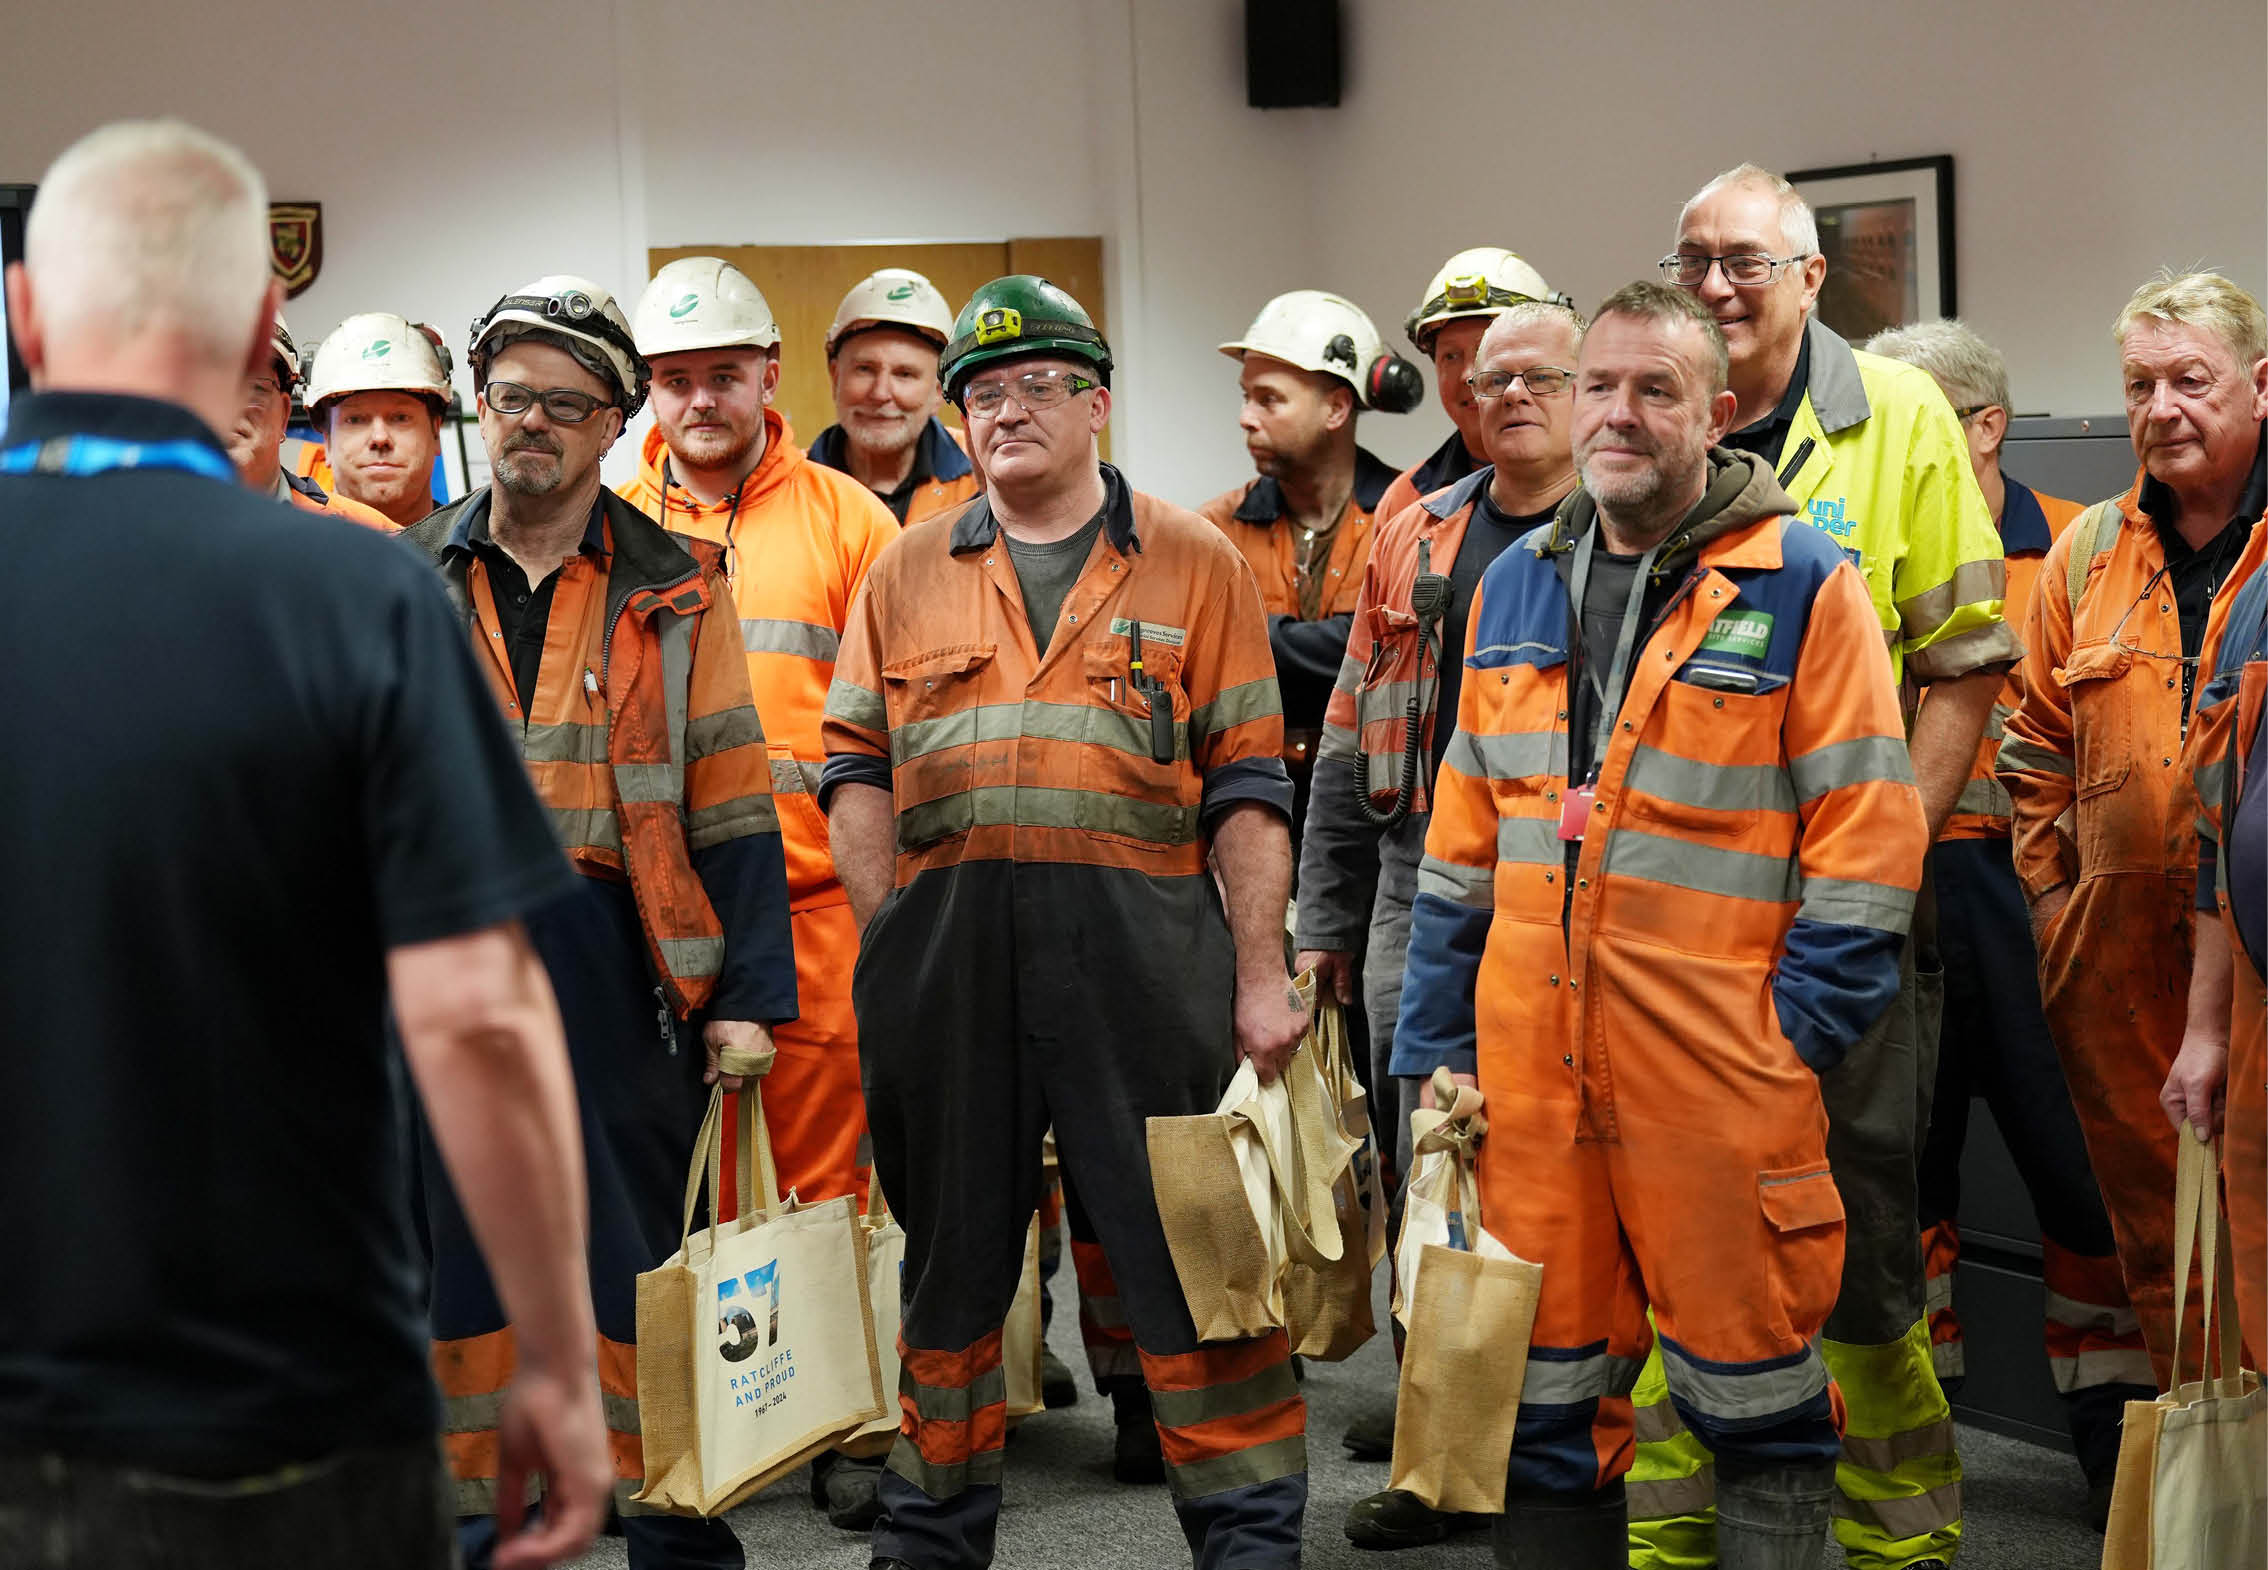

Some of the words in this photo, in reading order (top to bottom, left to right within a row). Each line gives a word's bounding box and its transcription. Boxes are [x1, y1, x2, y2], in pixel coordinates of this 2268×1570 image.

[1807, 497, 1845, 519] uni
[717, 1258, 780, 1363] 57
[730, 1349, 793, 1390] RATCLIFFE
[735, 1388, 762, 1408] AND
[764, 1366, 795, 1393] PROUD
